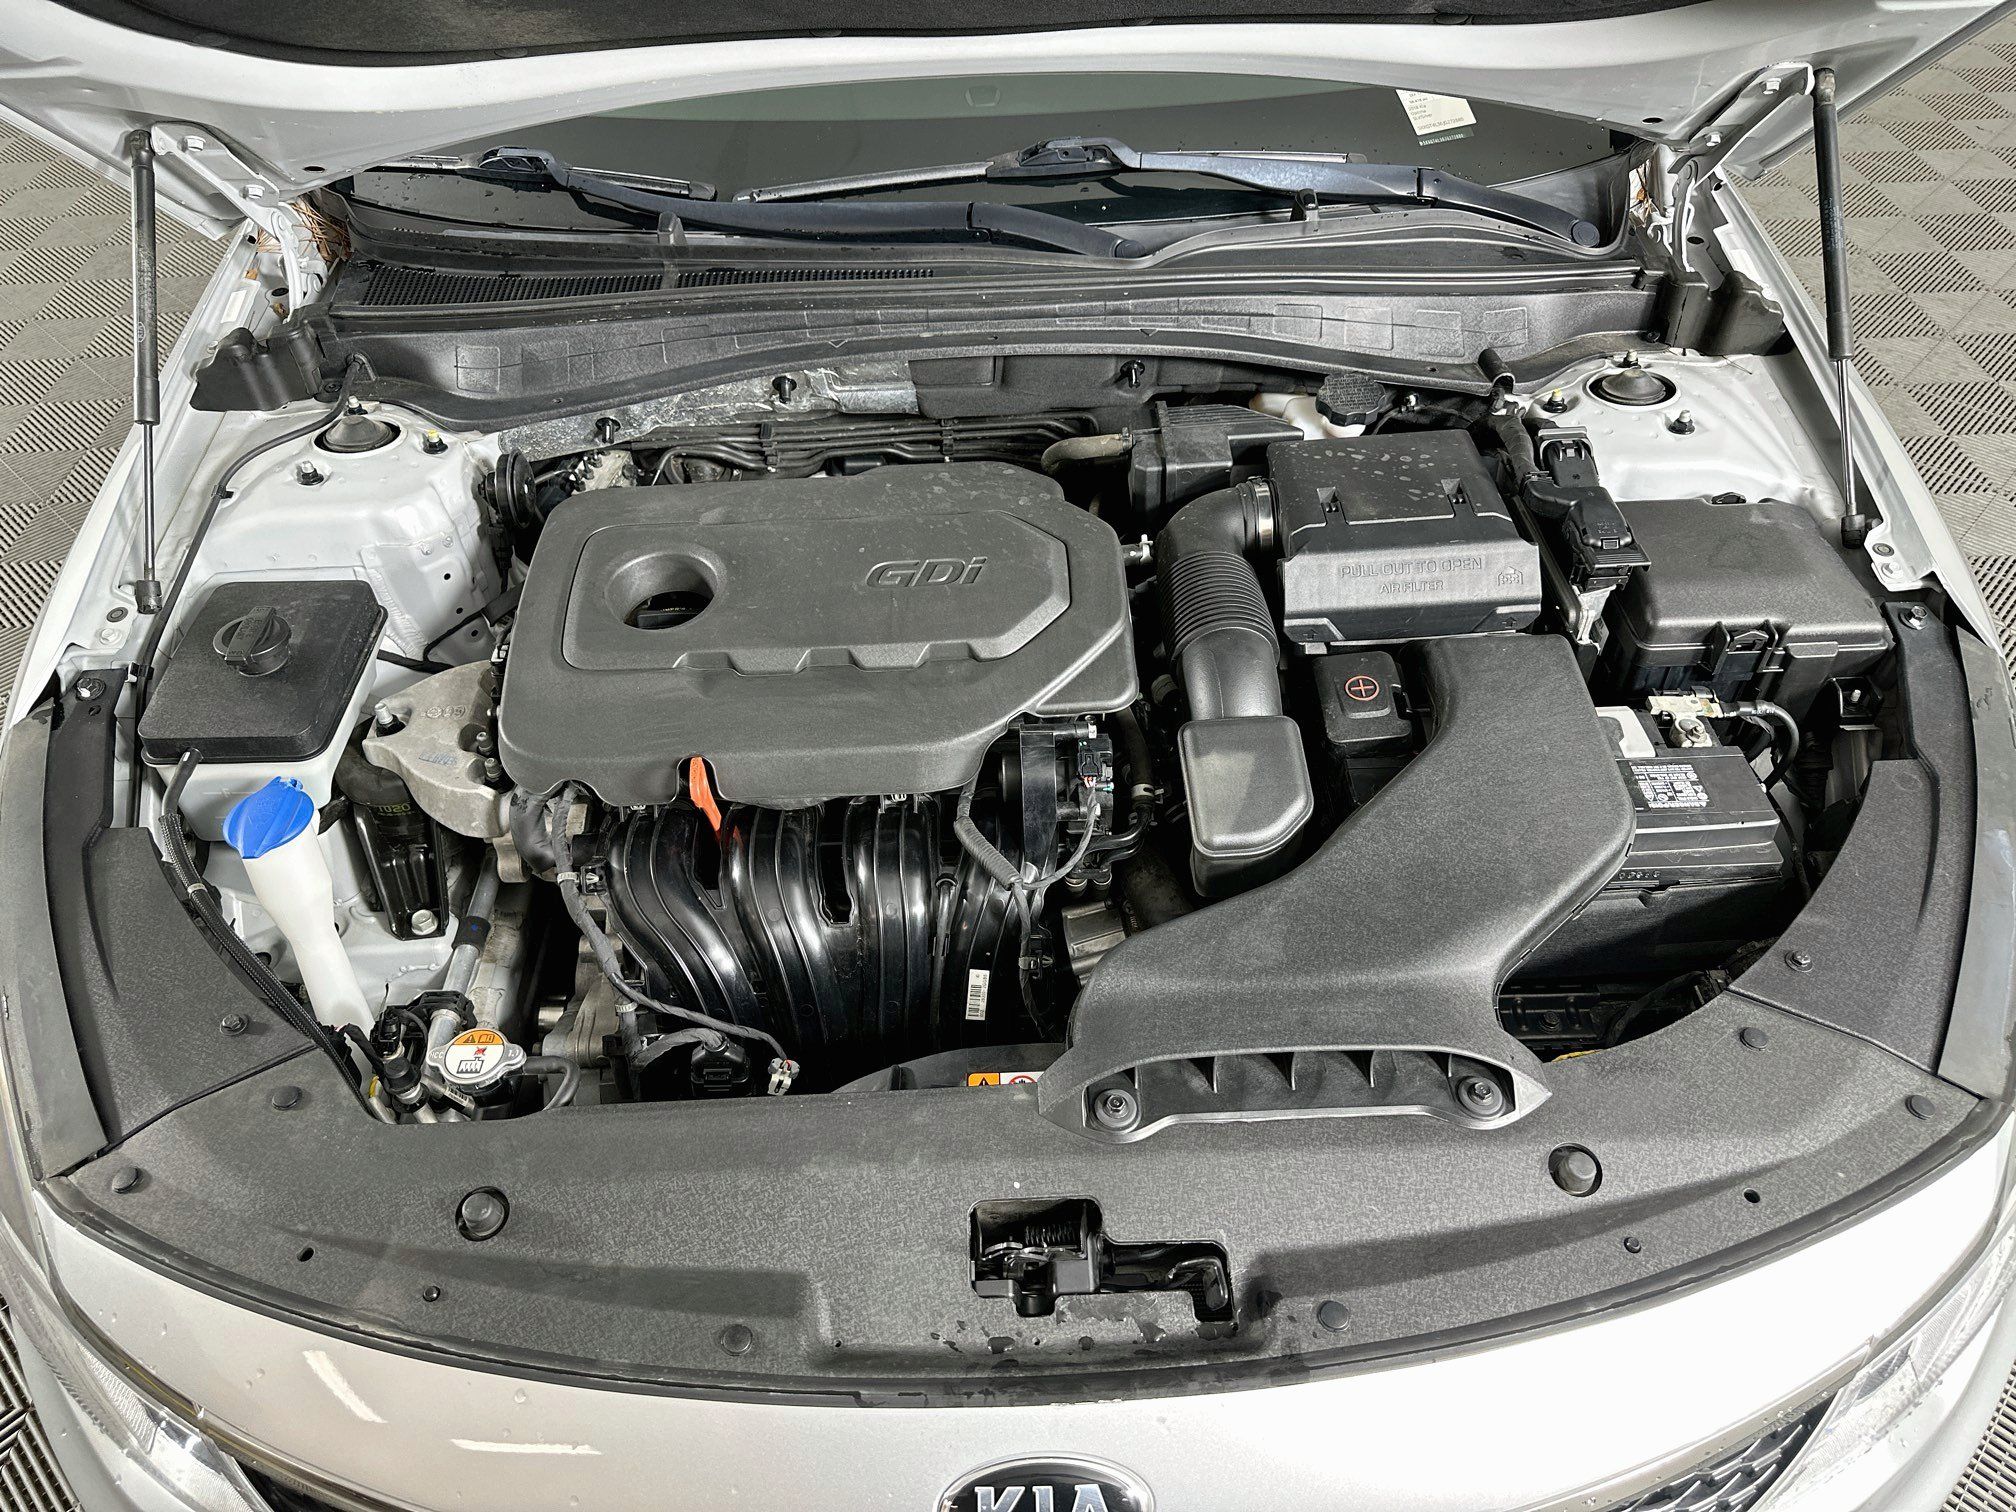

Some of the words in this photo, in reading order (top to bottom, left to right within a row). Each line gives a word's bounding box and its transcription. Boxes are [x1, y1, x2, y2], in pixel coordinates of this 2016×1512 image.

[864, 556, 988, 588] GDi
[1339, 562, 1380, 578] PULL
[1382, 561, 1414, 576] OUT
[1415, 559, 1438, 573] TO
[1441, 556, 1483, 571] OPEN
[1379, 582, 1401, 594] AIR
[1402, 580, 1444, 592] FILTER
[973, 1483, 1111, 1512] KIA
